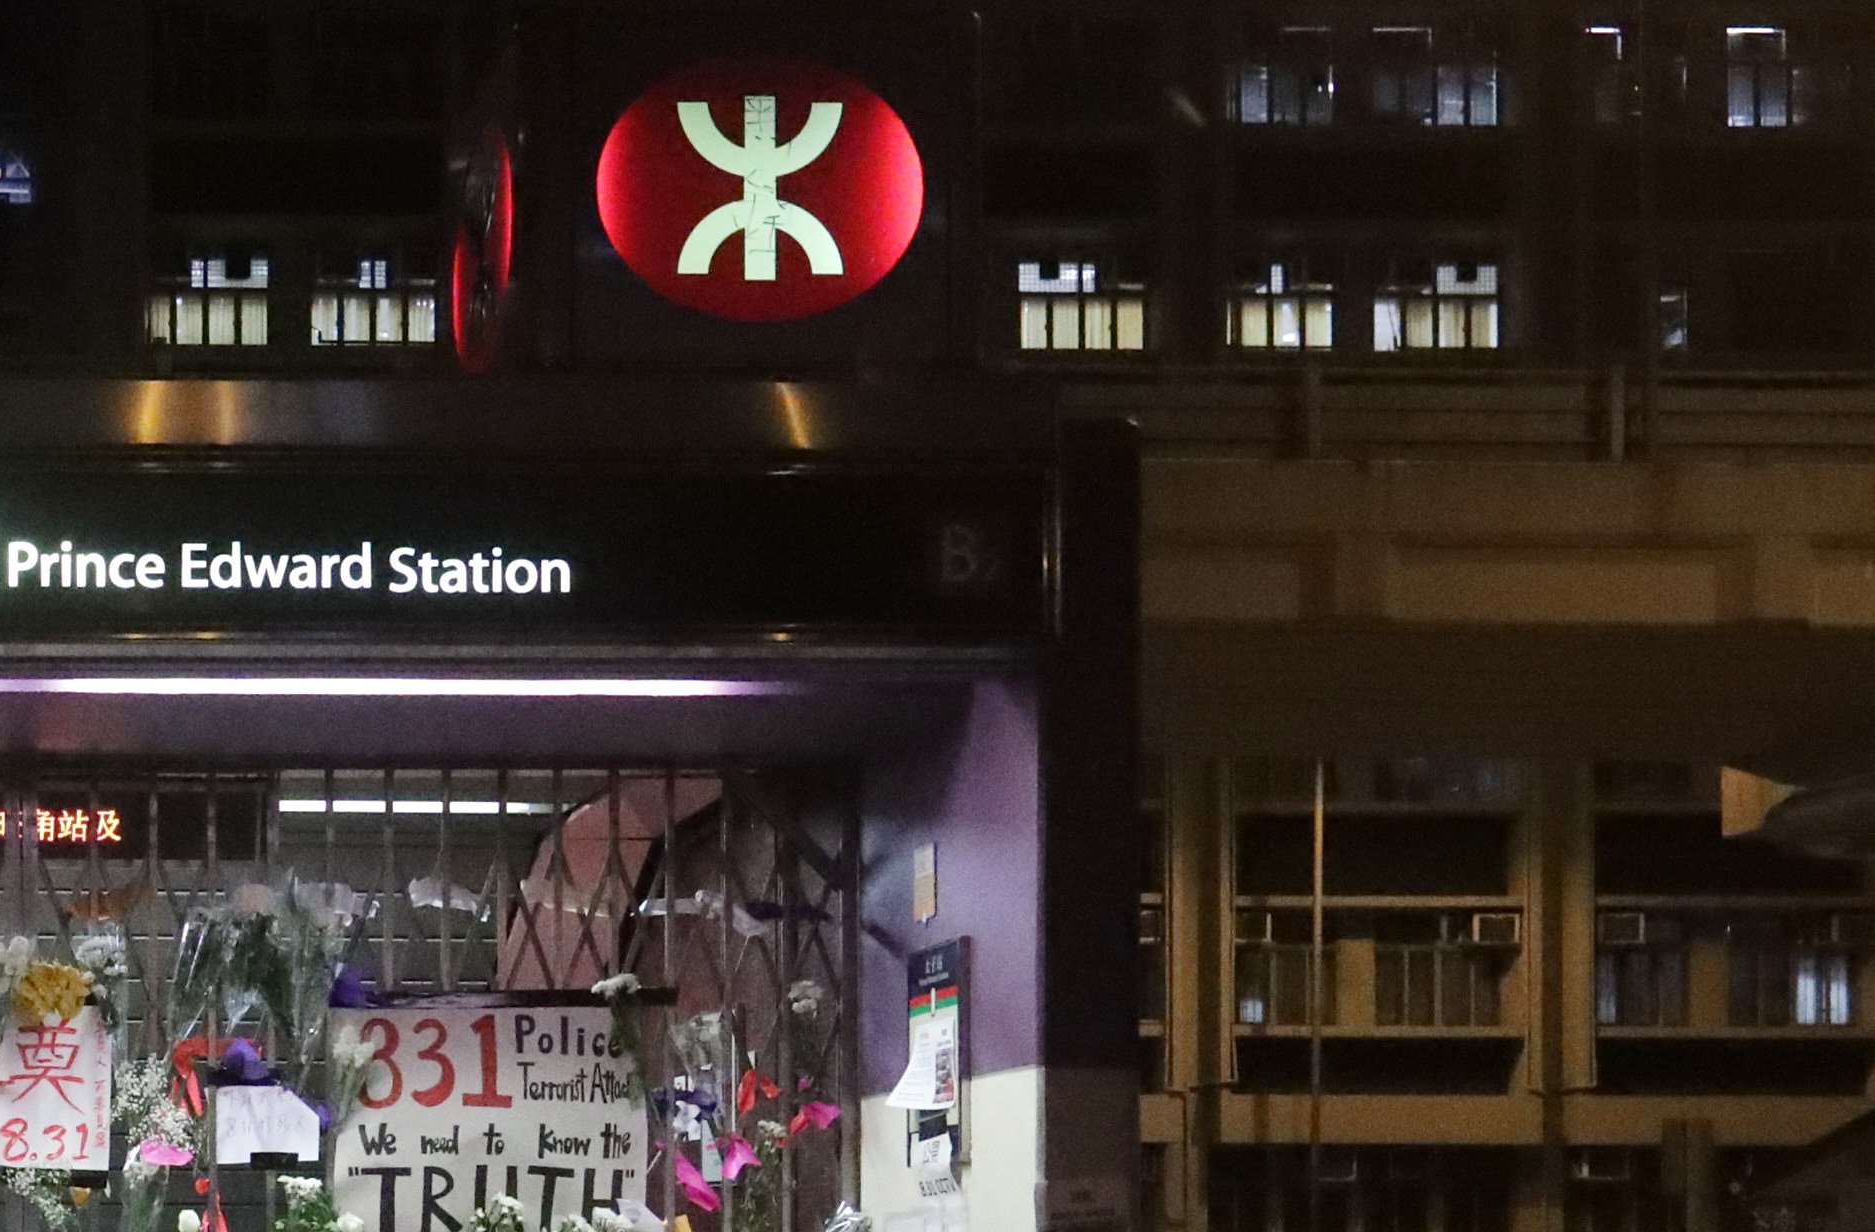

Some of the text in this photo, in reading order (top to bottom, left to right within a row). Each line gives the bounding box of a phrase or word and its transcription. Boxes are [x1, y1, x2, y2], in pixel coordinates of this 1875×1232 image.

[7, 540, 165, 588] Prince
[181, 541, 373, 589] Edward
[389, 546, 571, 593] Station
[515, 1014, 623, 1058] Police
[8, 1017, 85, 1116] 奠
[517, 1062, 588, 1103] Terrorist
[0, 1117, 89, 1163] 8.31
[358, 1122, 397, 1156] We
[420, 1124, 460, 1156] need
[482, 1122, 505, 1156] to
[599, 1122, 632, 1160] the
